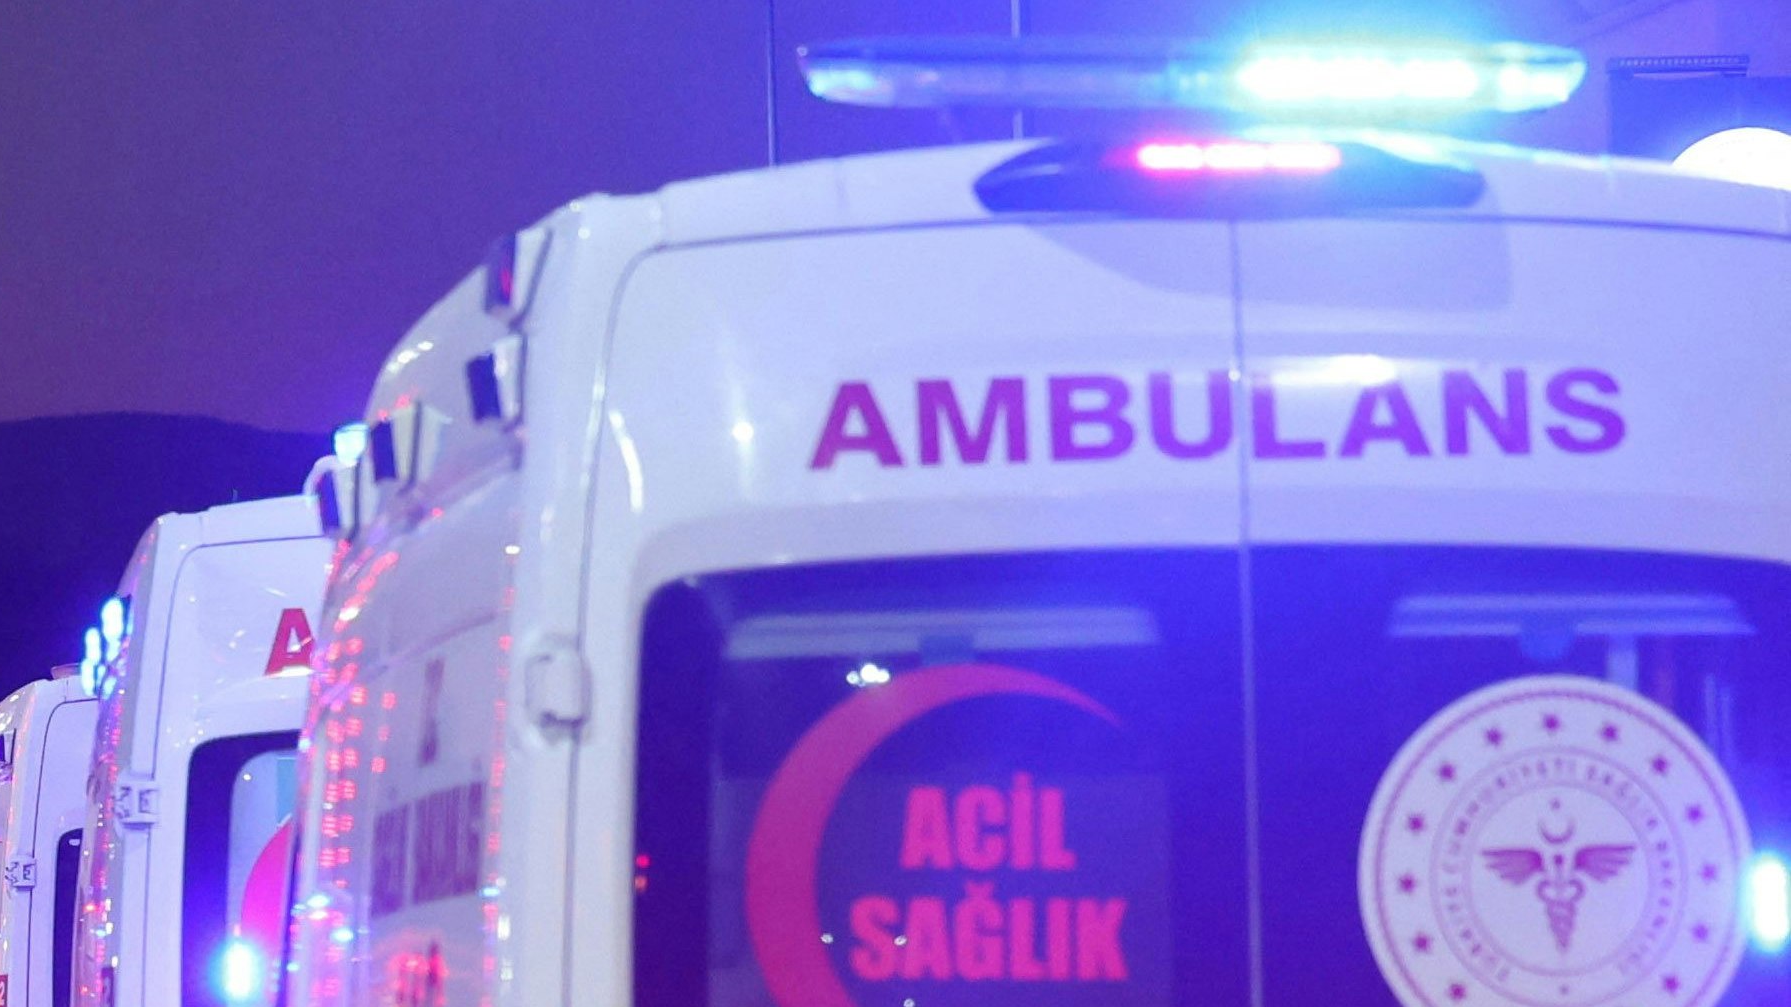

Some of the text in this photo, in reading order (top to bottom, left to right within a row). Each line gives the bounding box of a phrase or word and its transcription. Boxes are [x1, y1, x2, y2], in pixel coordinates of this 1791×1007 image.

[809, 366, 1628, 470] AMBULANS
[899, 770, 1080, 871] ACİL
[849, 880, 1130, 981] SAĞLIK
